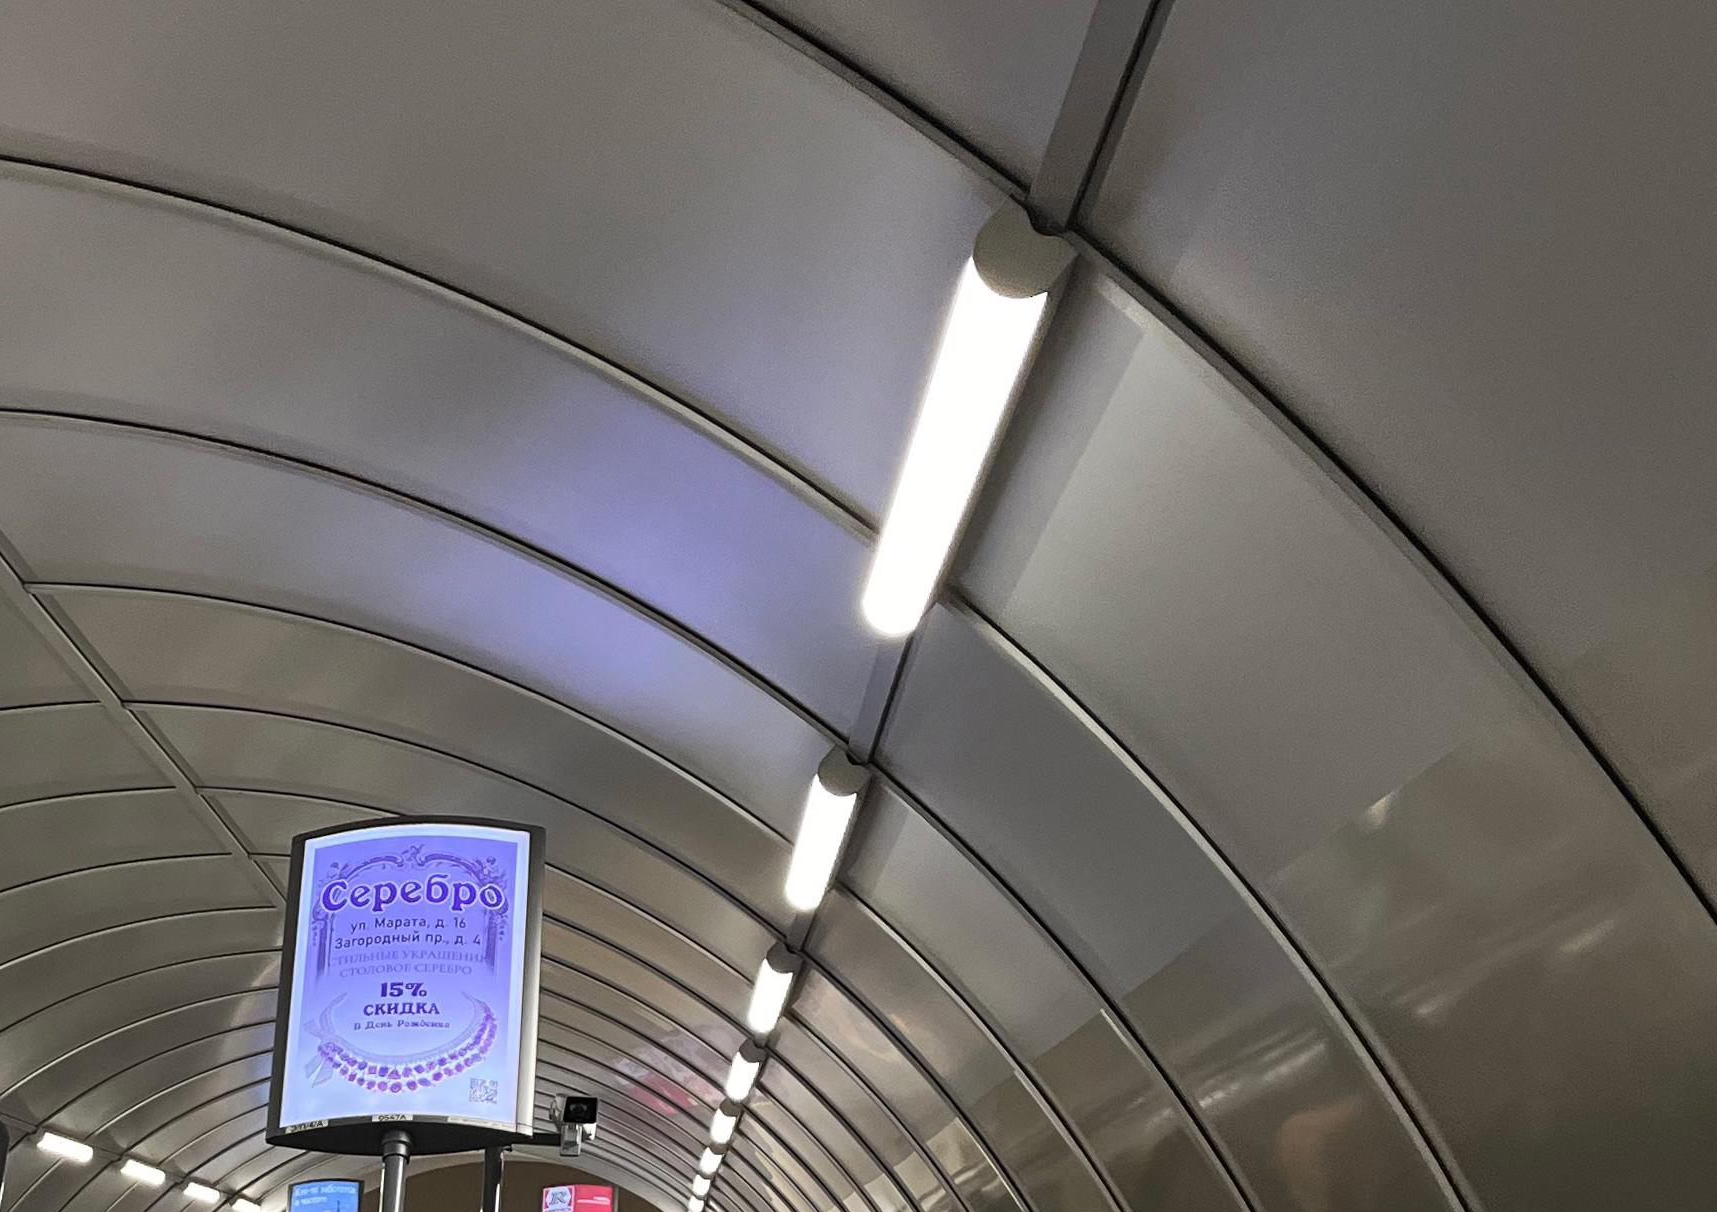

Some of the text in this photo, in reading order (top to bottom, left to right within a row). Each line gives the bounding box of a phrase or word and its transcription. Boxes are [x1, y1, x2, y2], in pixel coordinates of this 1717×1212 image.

[321, 874, 504, 913] Серебро
[374, 917, 430, 930] Марата,
[453, 917, 467, 929] 16
[334, 930, 420, 949] Загородный
[472, 934, 482, 945] 4
[333, 950, 491, 966] ТИЛЬНЫЕ УКРАШЕНИ
[339, 963, 472, 978] СТОЛОВОЕ СЕРЕБРО
[380, 982, 427, 998] 15%
[363, 1002, 440, 1016] СКИДКА
